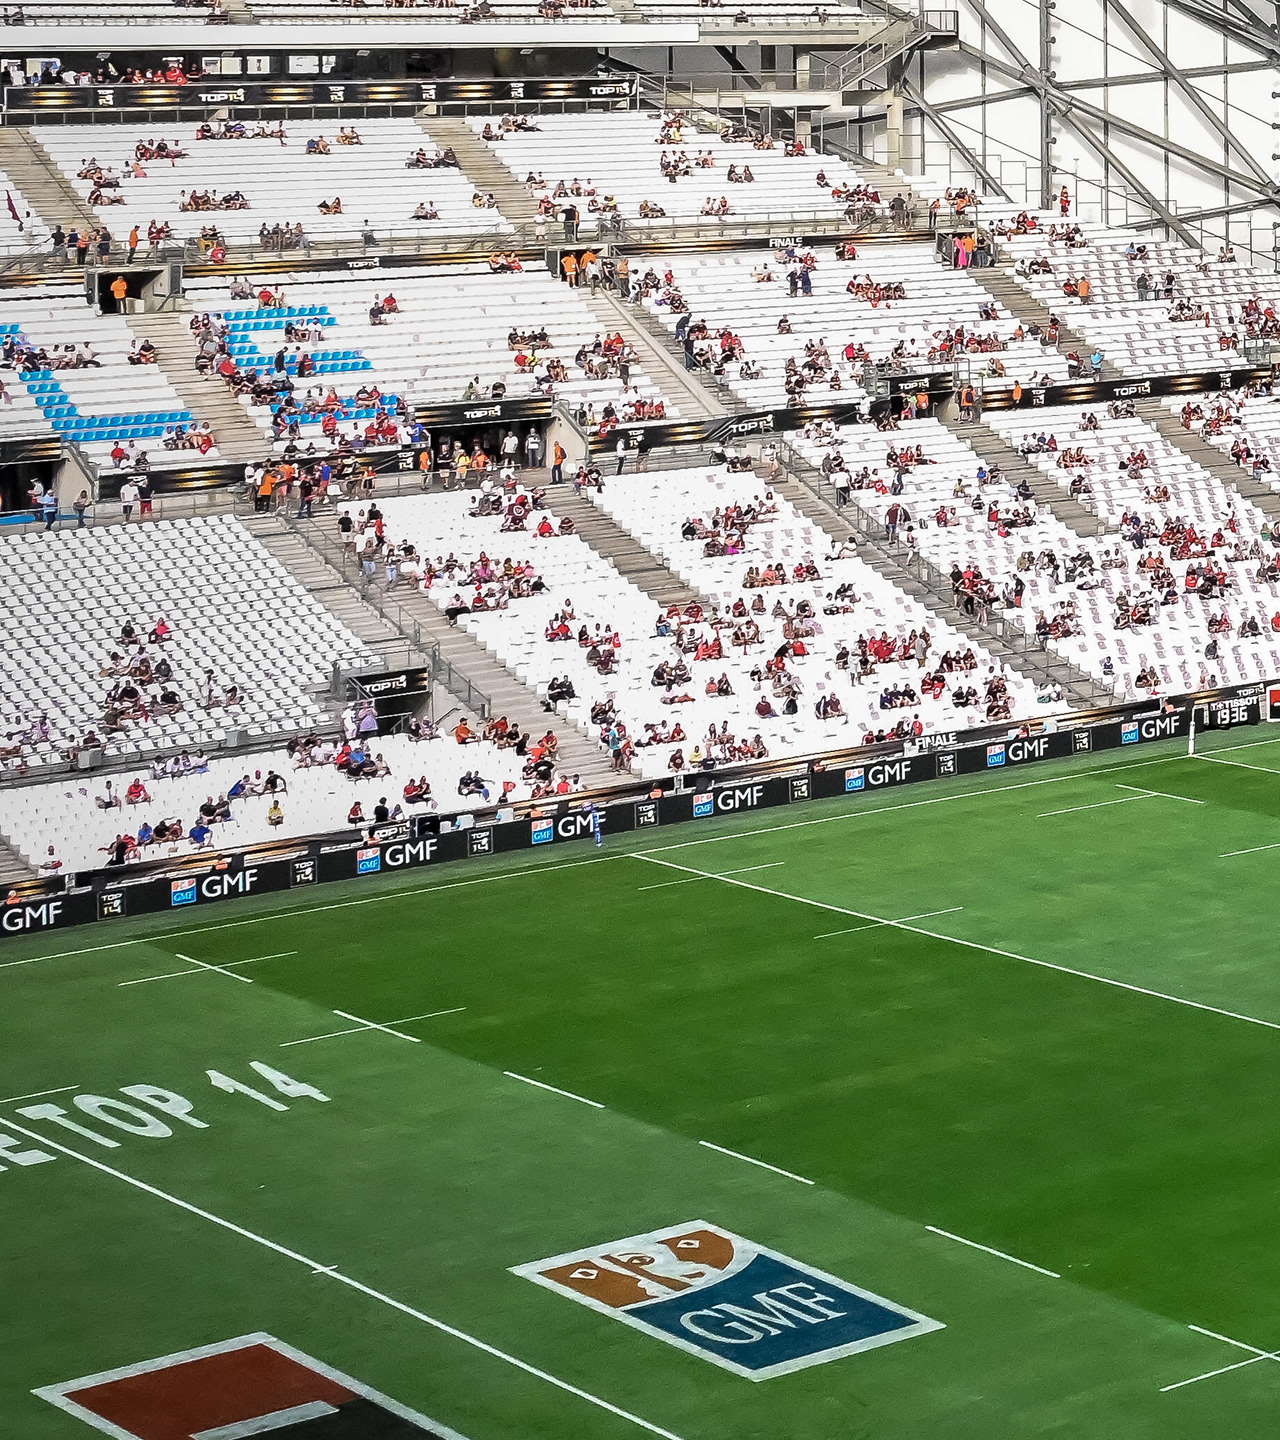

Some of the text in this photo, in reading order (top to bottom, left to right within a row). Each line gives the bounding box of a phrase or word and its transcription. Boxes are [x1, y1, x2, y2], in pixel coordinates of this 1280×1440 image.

[1114, 382, 1151, 396] TOP14
[464, 406, 501, 418] TOP14
[363, 676, 407, 693] TOP14
[1141, 716, 1180, 738] GMF
[915, 733, 957, 749] FINALE
[1008, 738, 1049, 761] GMF
[868, 761, 911, 786] GMF
[717, 785, 764, 811] GMF
[384, 838, 438, 866] GMF
[202, 869, 258, 897] GMF
[2, 901, 63, 931] GMF
[15, 1061, 332, 1148] TOP 14
[680, 1282, 848, 1344] GMF
